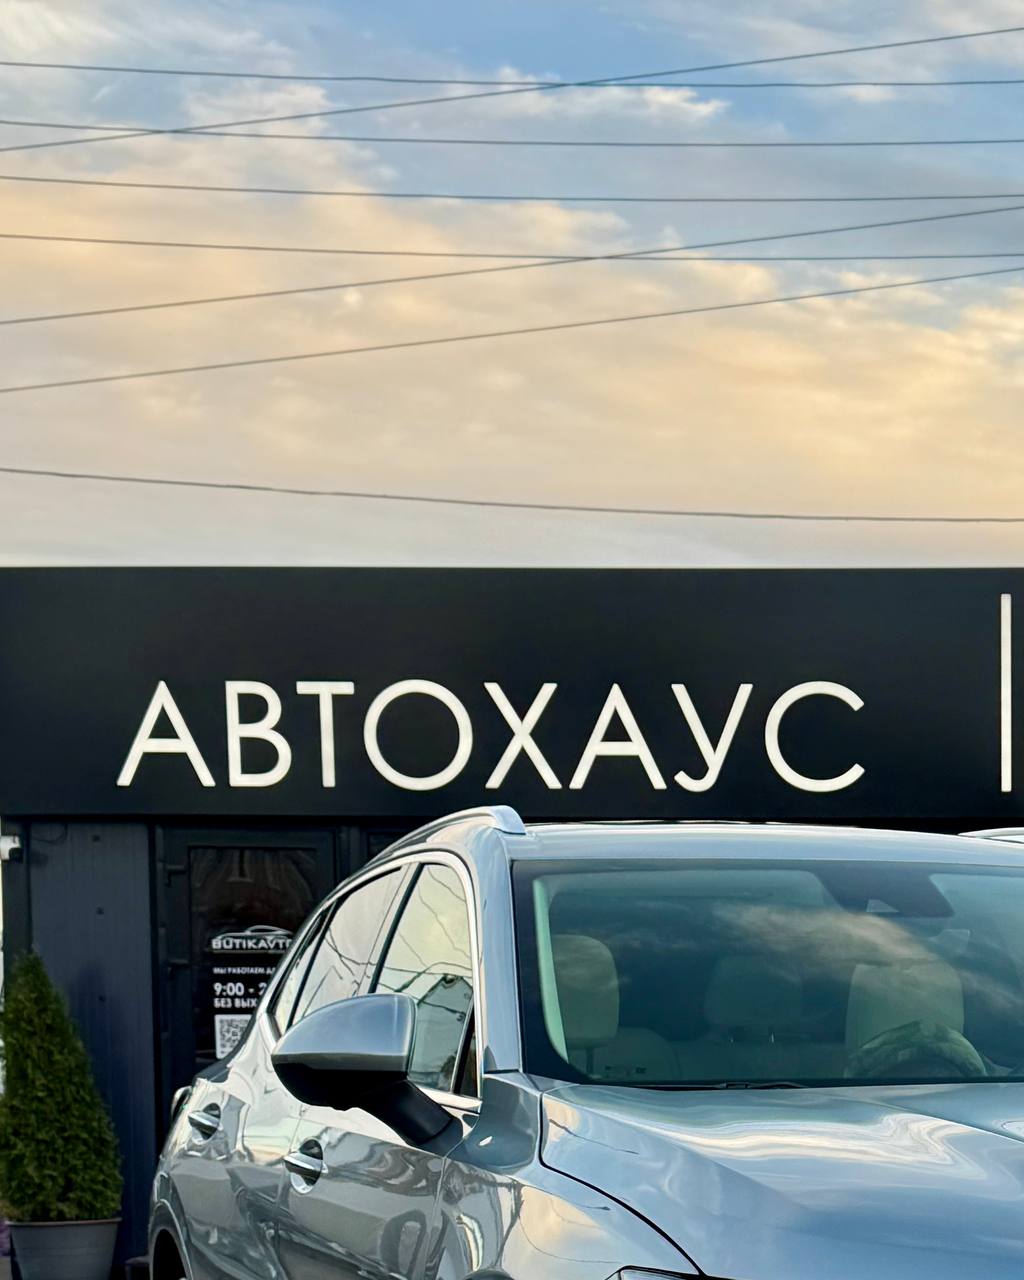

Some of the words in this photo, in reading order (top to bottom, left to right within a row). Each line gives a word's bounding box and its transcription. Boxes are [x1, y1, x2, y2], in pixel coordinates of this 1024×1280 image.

[116, 679, 865, 792] АВТОХАУС
[213, 982, 245, 996] 9:00
[213, 998, 233, 1008] БЕЗ
